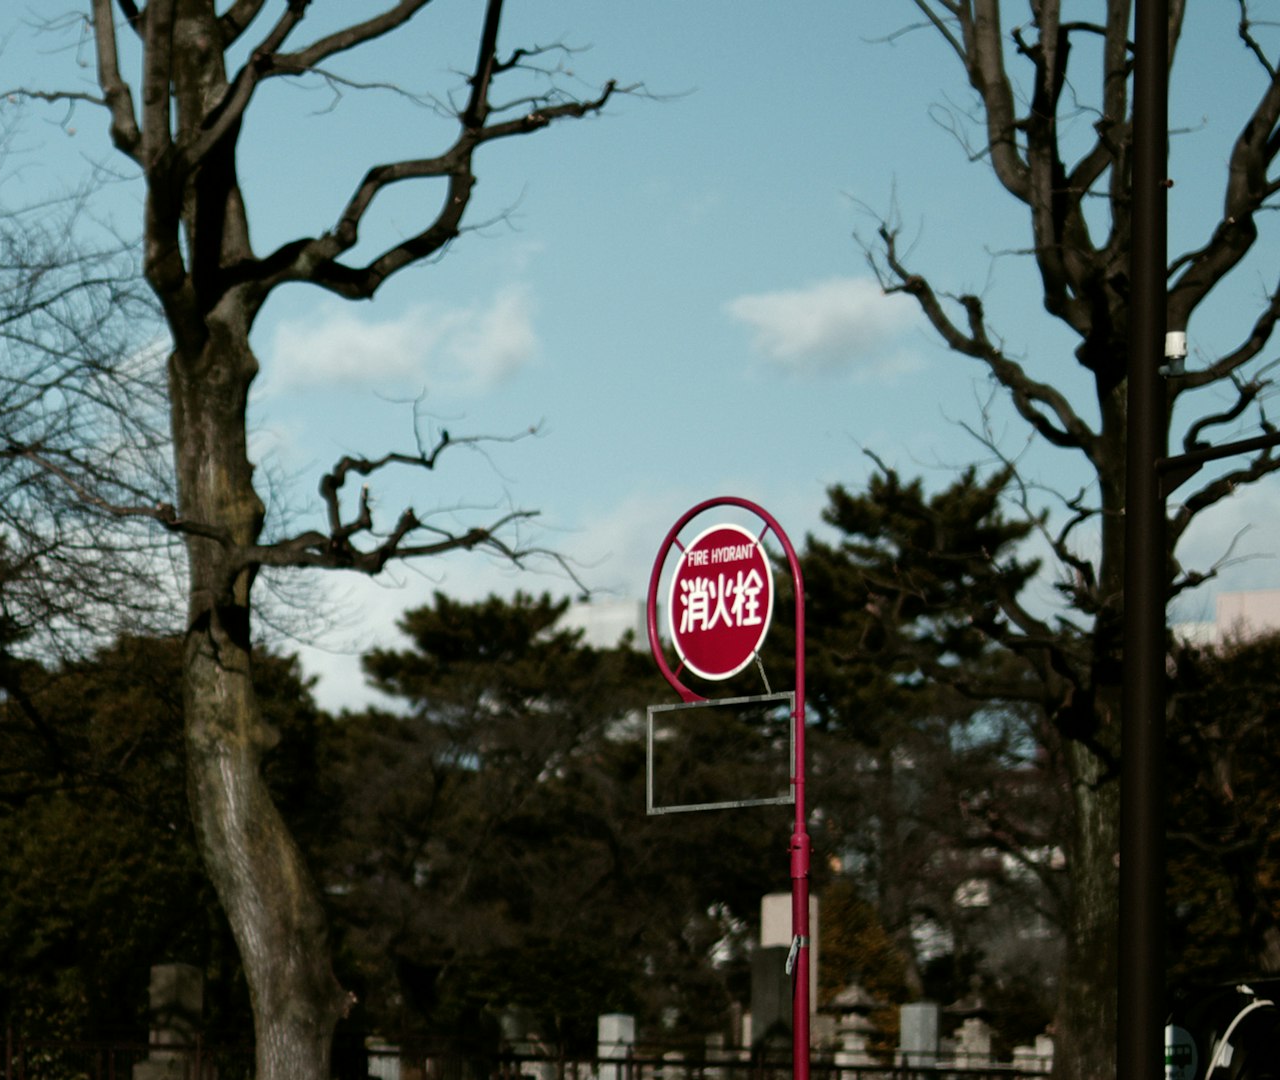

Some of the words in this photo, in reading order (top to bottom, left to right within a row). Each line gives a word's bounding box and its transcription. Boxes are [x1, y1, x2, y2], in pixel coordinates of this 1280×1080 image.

[687, 549, 709, 567] FIRE
[710, 543, 754, 564] HYDRANT
[679, 568, 764, 634] 消火栓
